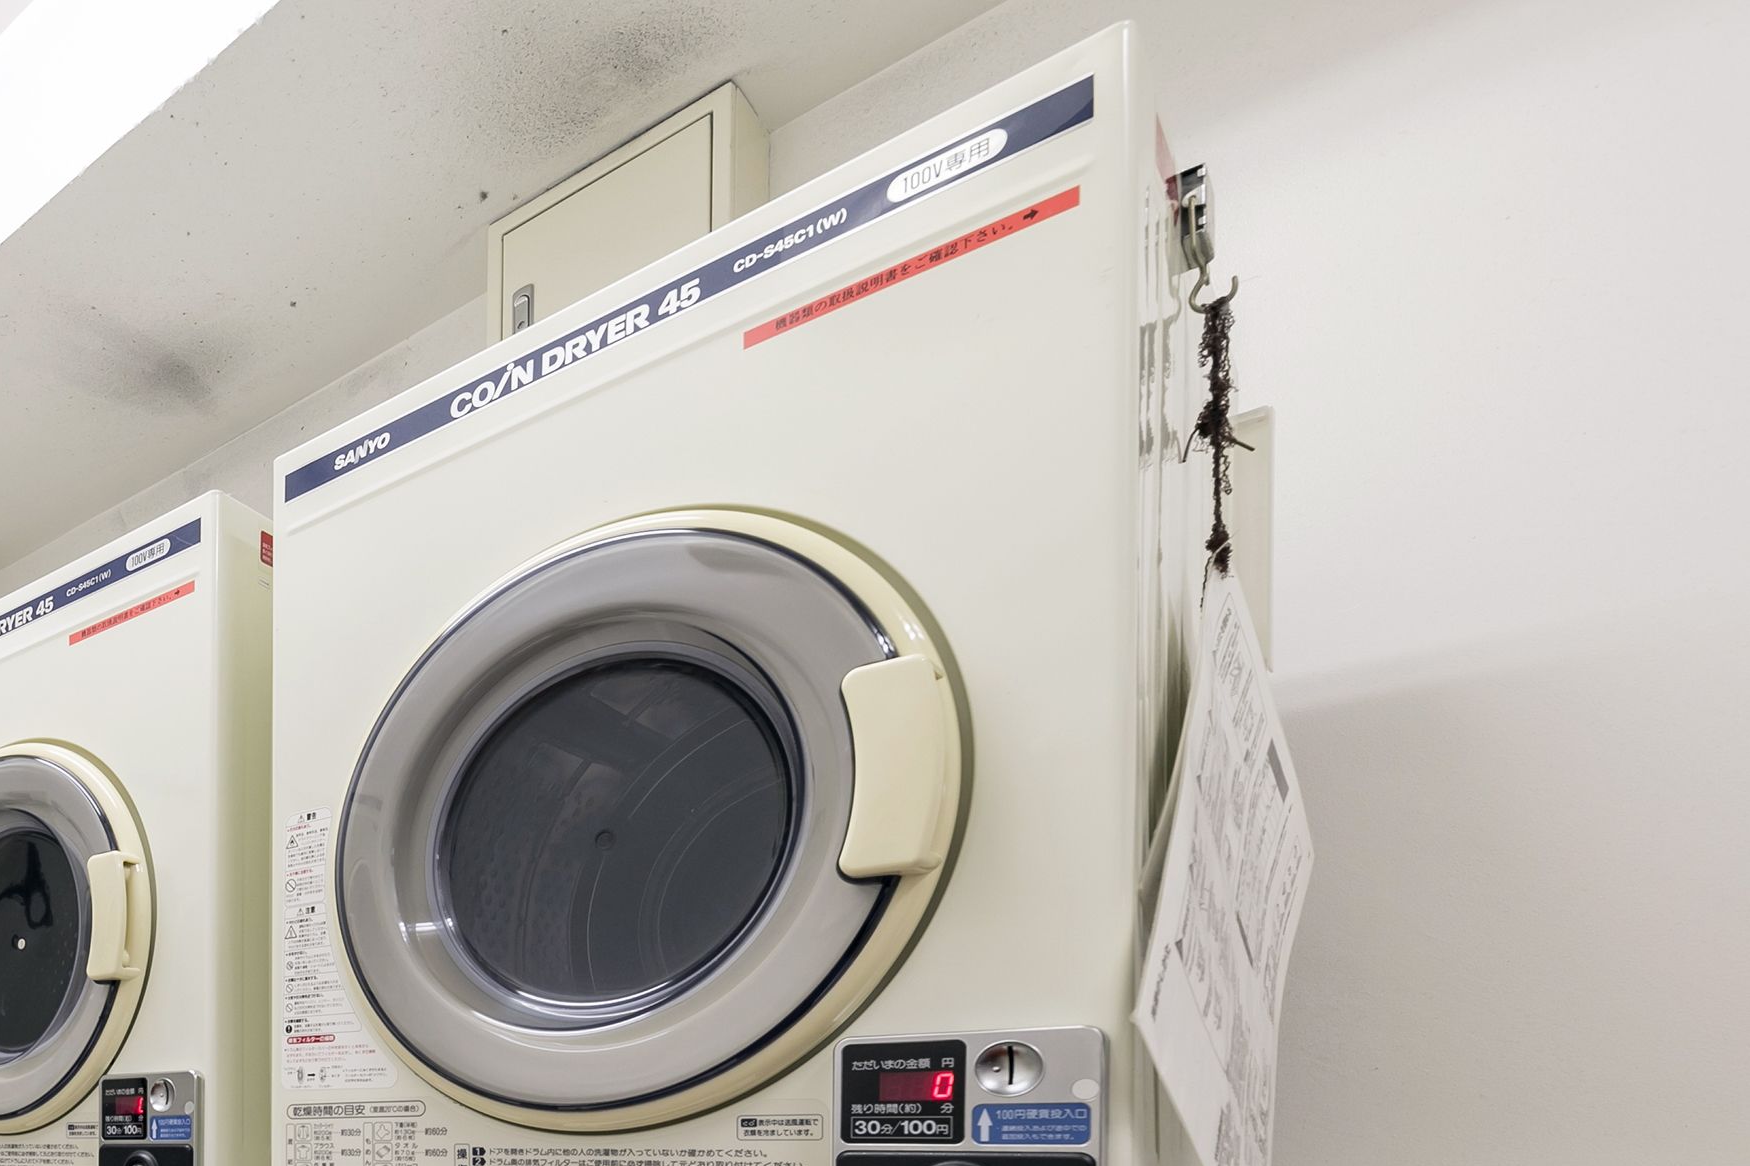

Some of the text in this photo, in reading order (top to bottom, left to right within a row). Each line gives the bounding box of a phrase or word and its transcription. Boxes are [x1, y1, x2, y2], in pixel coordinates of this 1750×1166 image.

[333, 430, 390, 471] SANYO
[541, 303, 650, 369] DRYER
[658, 279, 701, 320] 45
[733, 207, 847, 274] CD-S45C1(W)
[902, 136, 992, 195] 100V専用
[35, 596, 54, 616] 45
[66, 569, 111, 597] CD-S45C1(W)
[851, 1057, 954, 1071] ただいまの金額 円
[933, 1072, 954, 1098] 0
[293, 1105, 366, 1116] 乾燥時間の目安
[851, 1103, 954, 1114] 残り時間(約) 分
[996, 1108, 1088, 1119] 100円硬貨投入口
[758, 1119, 819, 1127] 表示中は送風運転で
[854, 1121, 949, 1136] 30分/100円
[489, 1147, 768, 1157] ドアを開きドラム内に他の人の洗濯物が入っていないか確かめてください。
